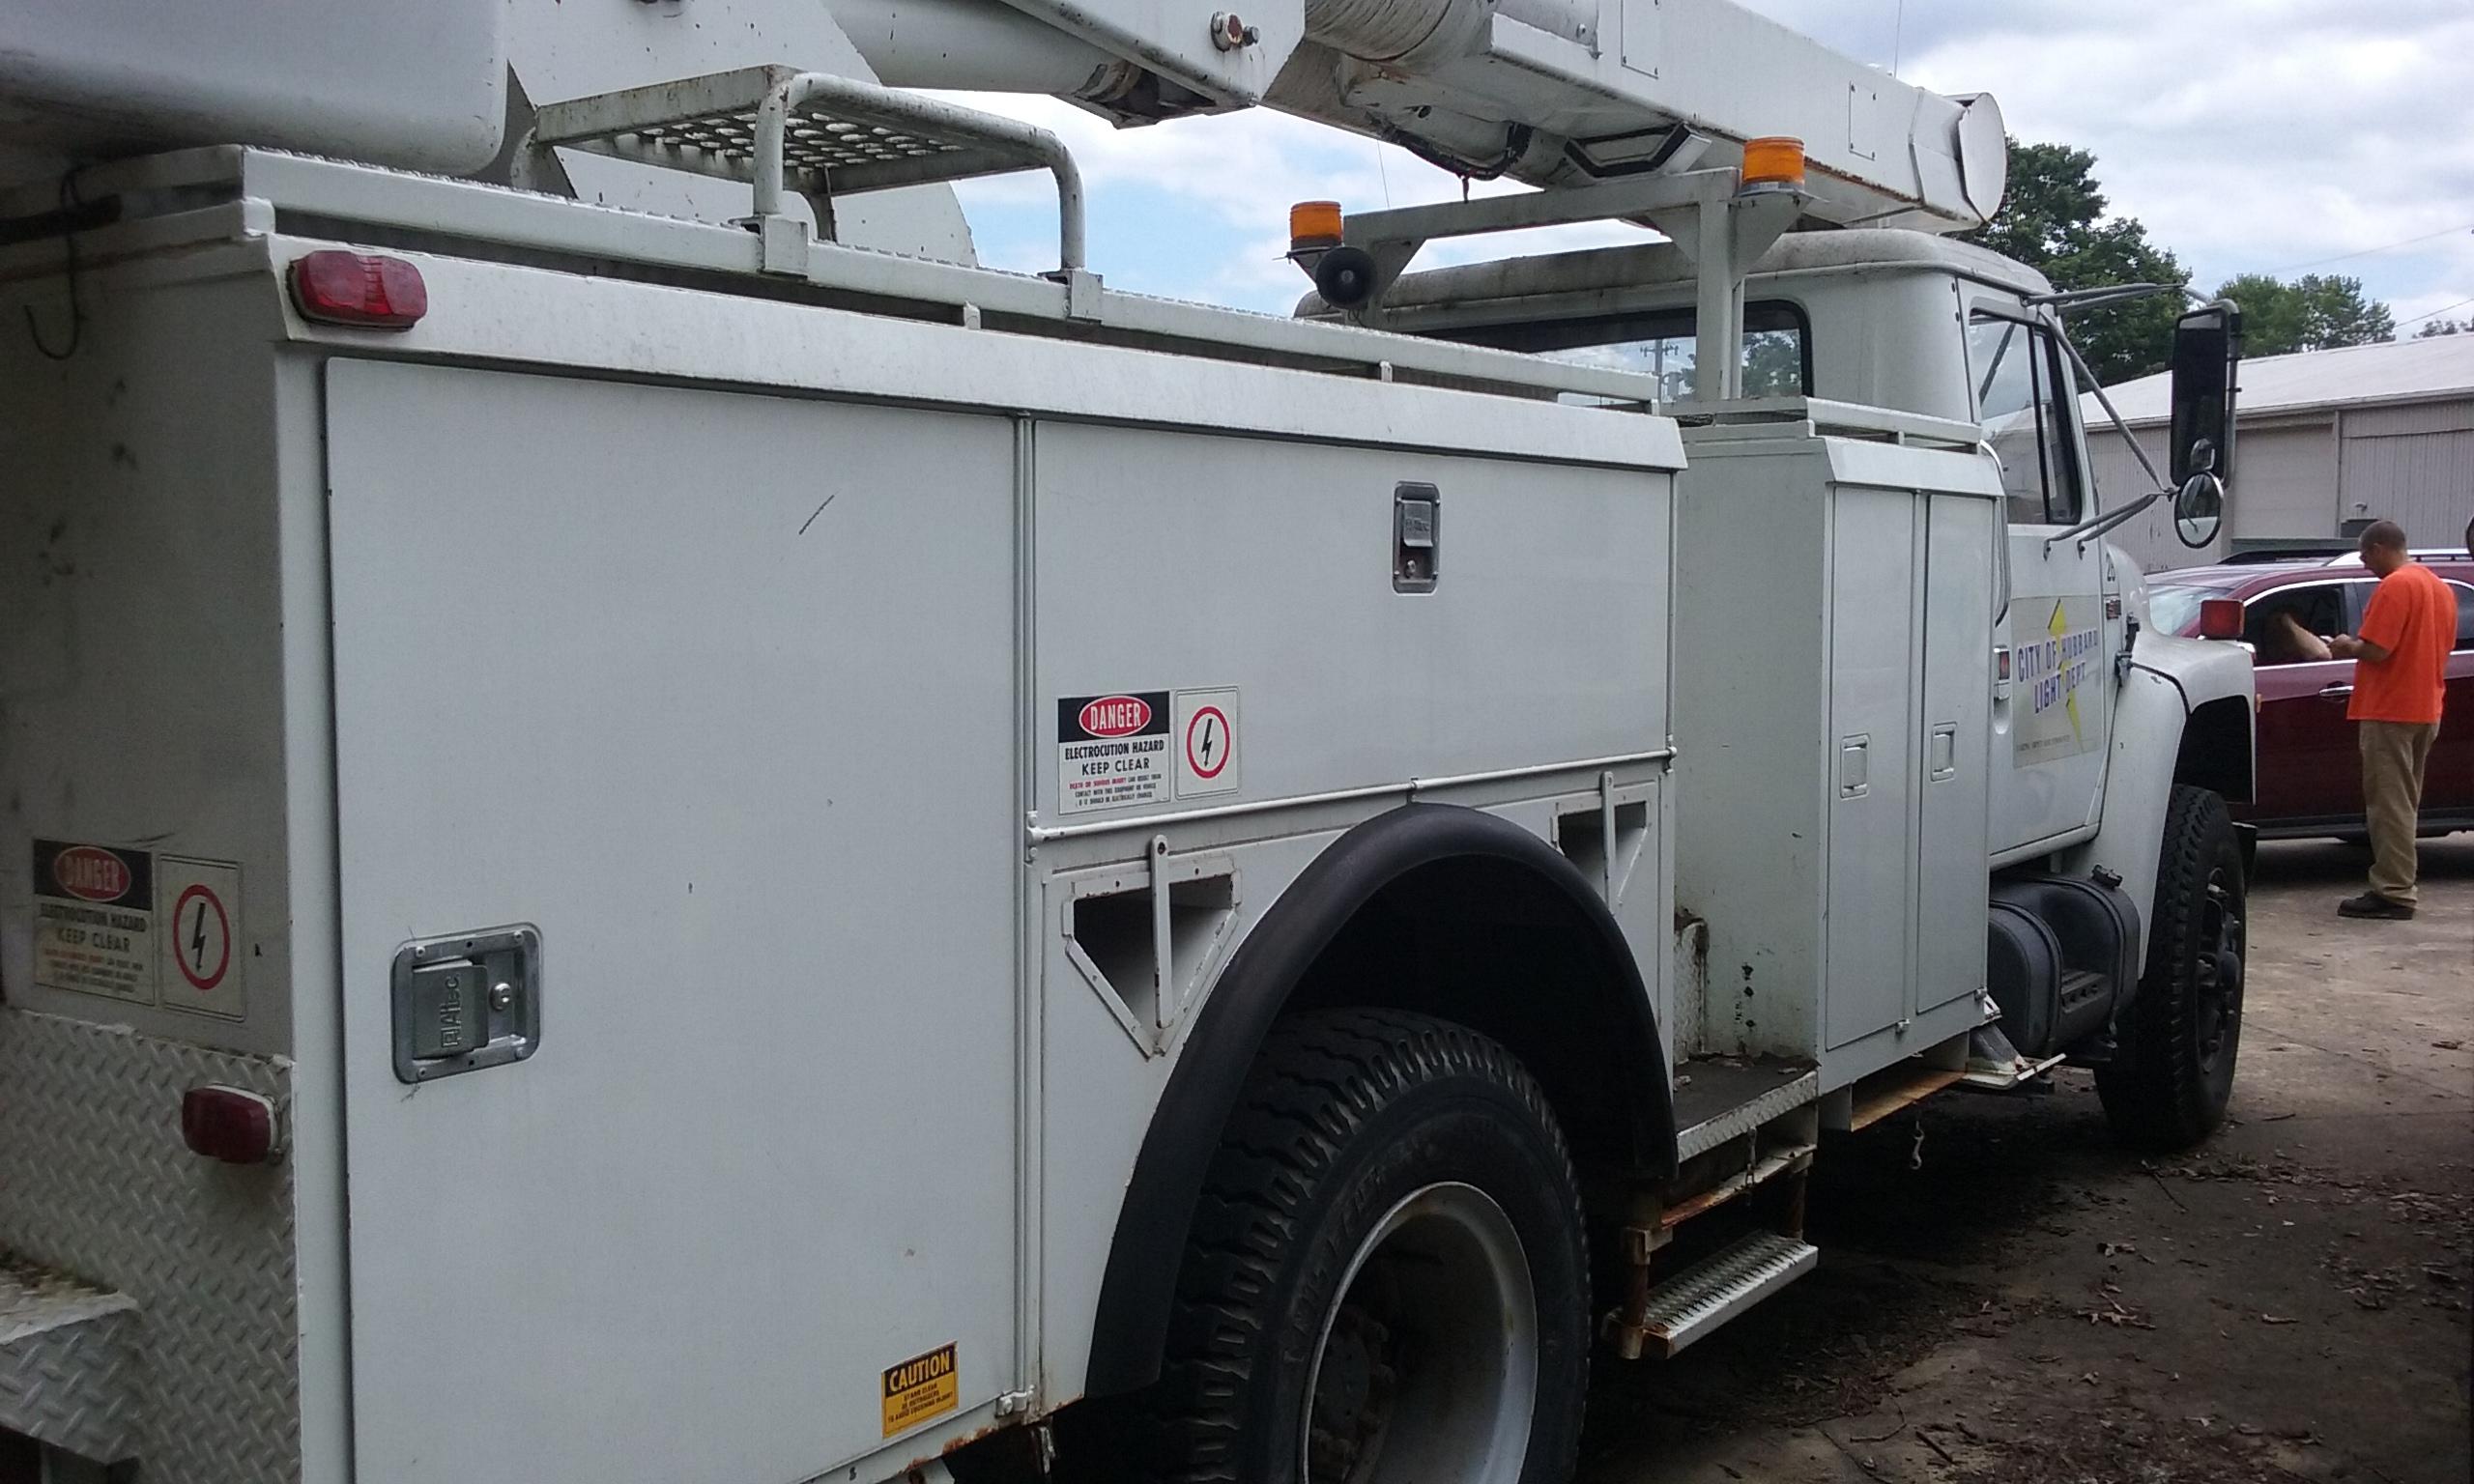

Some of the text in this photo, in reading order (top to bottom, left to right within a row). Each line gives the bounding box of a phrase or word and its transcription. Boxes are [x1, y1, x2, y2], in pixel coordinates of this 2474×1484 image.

[2018, 644, 2041, 682] CITY
[2046, 641, 2057, 670] OF
[2034, 662, 2086, 714] LIGHT DEPT
[1090, 702, 1141, 730] DANGER
[1065, 739, 1165, 760] ELECTROCUTION HAZARD
[1081, 756, 1150, 776] KEEP CLEAR
[64, 856, 120, 892] DANGER
[57, 928, 130, 953] KEEP CLEAR
[889, 1351, 950, 1392] CAUTION
